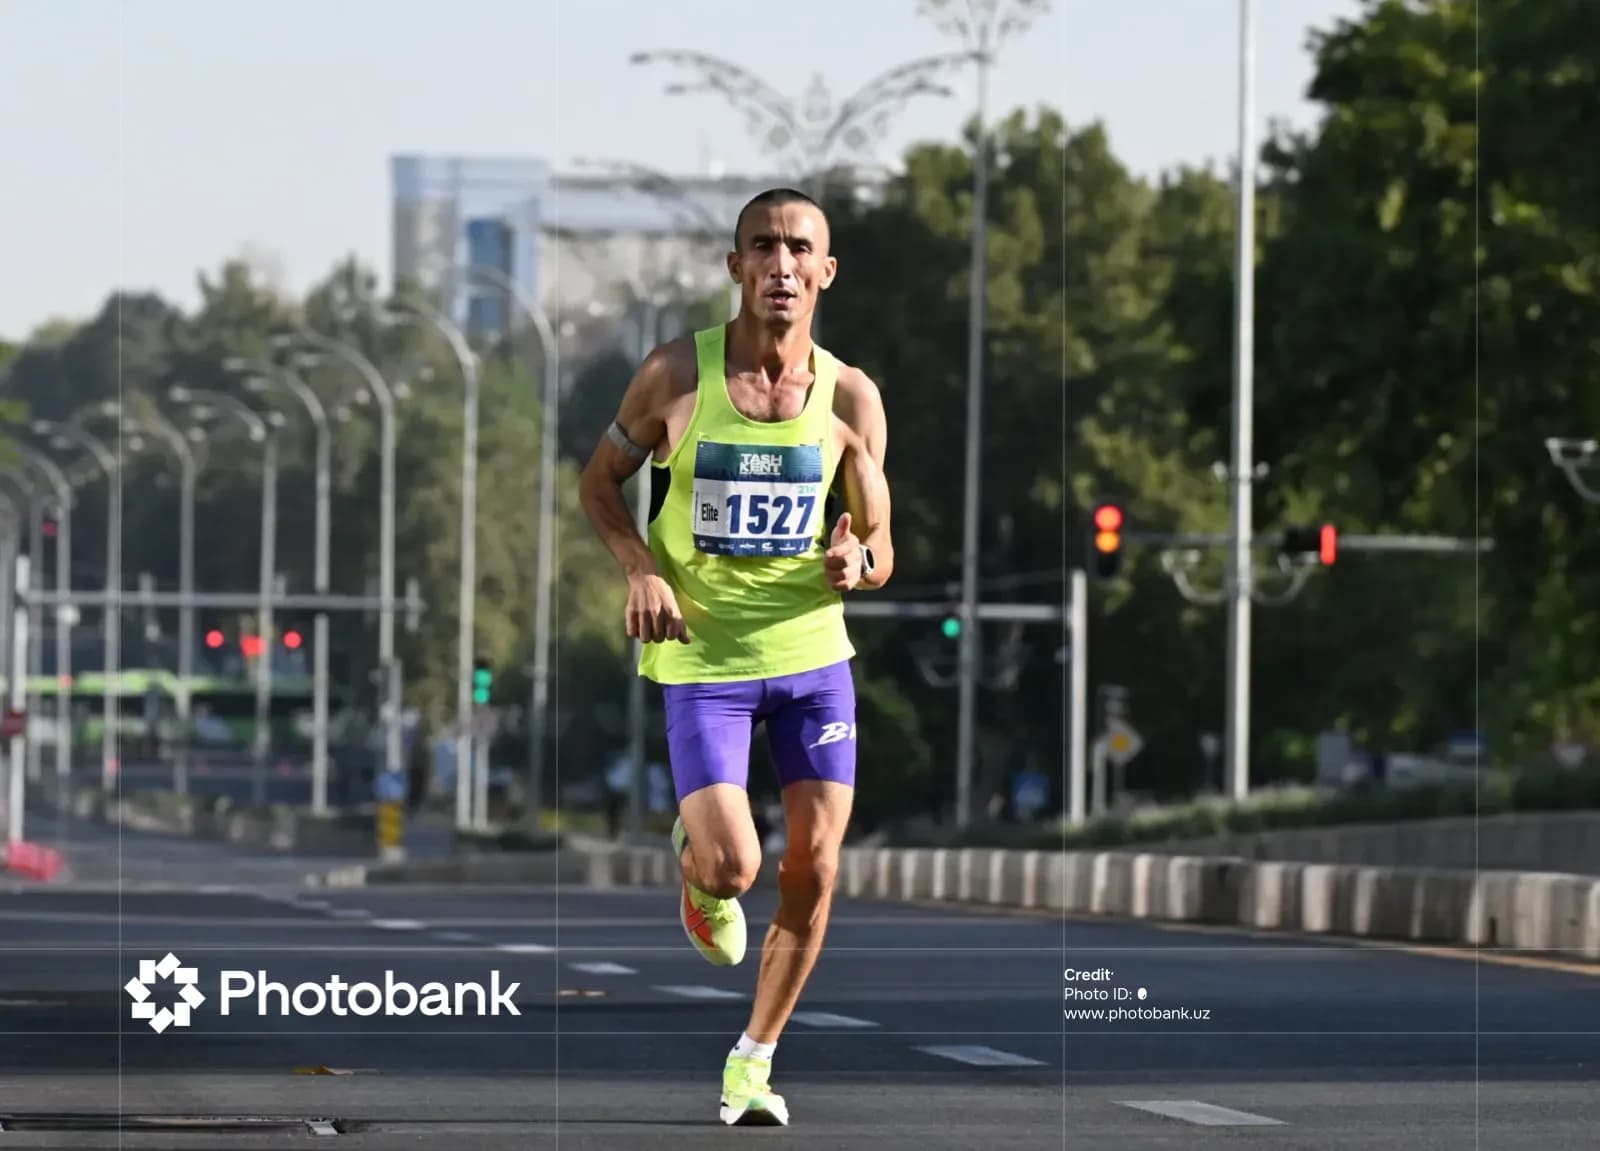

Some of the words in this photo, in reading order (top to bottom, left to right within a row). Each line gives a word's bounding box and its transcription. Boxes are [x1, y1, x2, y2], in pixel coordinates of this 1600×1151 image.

[740, 453, 783, 466] TASH
[739, 464, 780, 474] KENT
[701, 503, 719, 522] Elite
[726, 494, 816, 535] 1527
